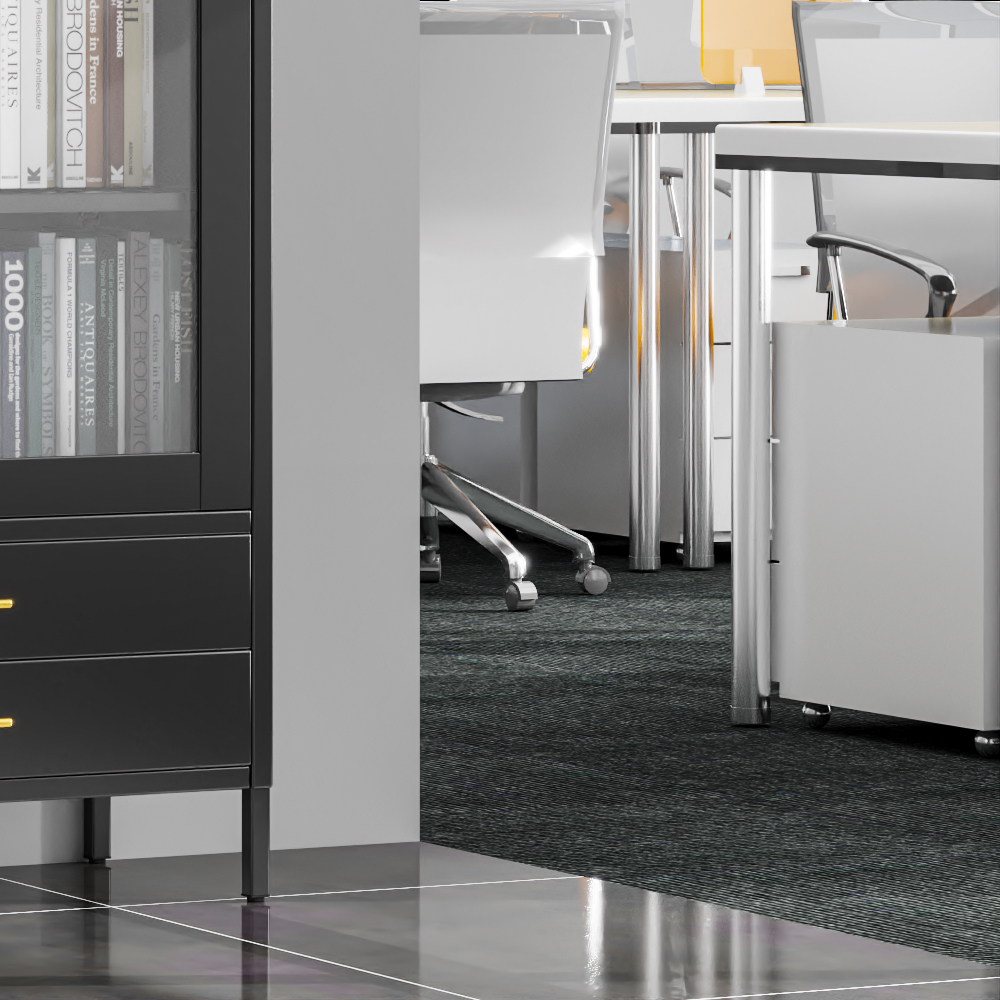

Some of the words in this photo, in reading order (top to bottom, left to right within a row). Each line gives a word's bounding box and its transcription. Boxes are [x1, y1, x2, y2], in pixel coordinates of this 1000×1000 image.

[35, 7, 43, 56] Residential
[89, 37, 100, 52] in
[116, 10, 124, 58] HOUSING
[35, 57, 43, 110] Architecture
[89, 55, 100, 105] France
[5, 259, 24, 332] 1000
[133, 239, 147, 323] ALEXEY
[42, 295, 53, 345] BOOK
[107, 290, 115, 341] Contemporary
[152, 313, 160, 363] Gardens
[83, 302, 95, 427] ANTIQUAIRES
[152, 366, 160, 377] in
[42, 366, 53, 457] SYMBOLS
[133, 331, 147, 452] BRODOVITC
[152, 381, 160, 421] France
